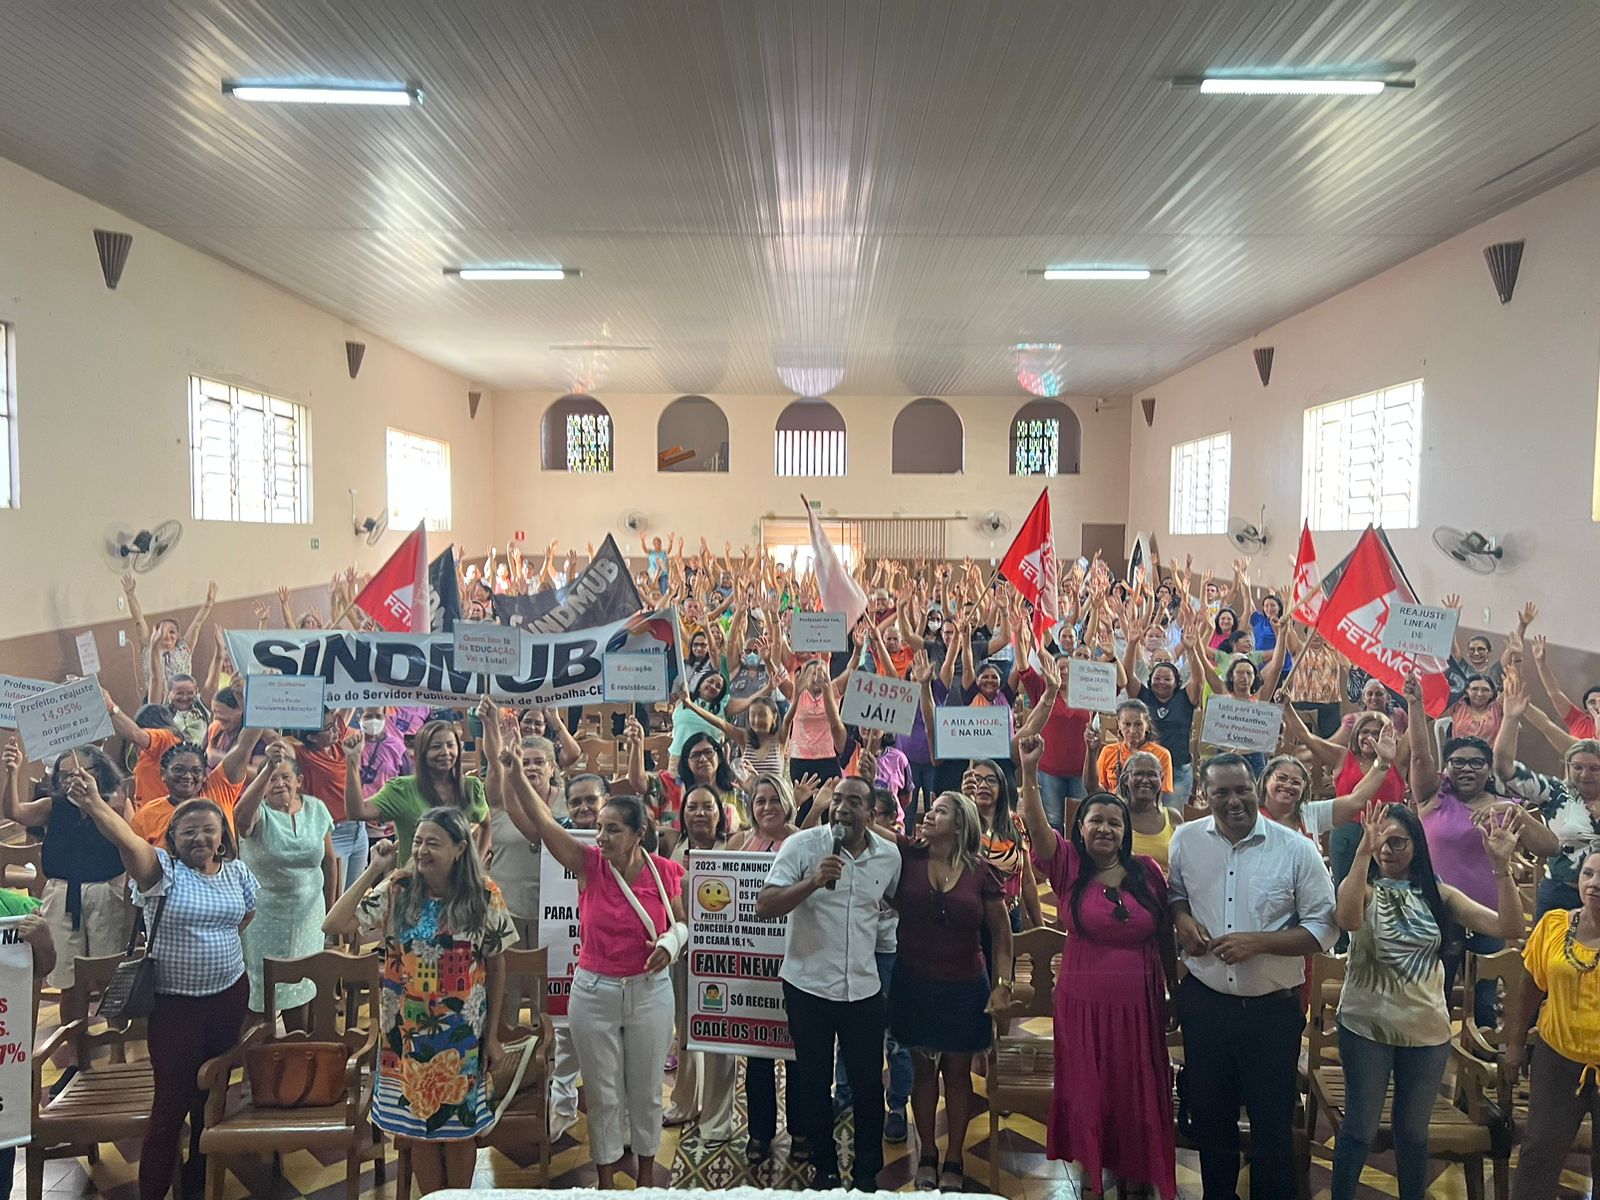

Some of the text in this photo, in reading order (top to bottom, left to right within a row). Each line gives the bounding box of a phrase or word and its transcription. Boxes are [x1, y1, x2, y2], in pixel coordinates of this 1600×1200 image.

[1400, 607, 1446, 620] REAJUSTE
[1403, 618, 1437, 630] LINEAR
[59, 683, 94, 700] reajuste
[345, 690, 359, 700] do
[363, 688, 412, 700] Servidor
[518, 697, 532, 705] de
[855, 677, 913, 703] 14,95%
[42, 702, 82, 722] 14,95%
[860, 703, 896, 724] JÁ!!
[42, 728, 53, 737] no
[79, 716, 89, 725] na
[958, 728, 972, 736] NA
[695, 861, 716, 871] 2023
[722, 861, 740, 872] MEC
[739, 891, 749, 900] OS
[544, 906, 573, 920] PARA
[700, 912, 727, 920] PREFEITO
[693, 923, 733, 934] CONCEDER
[734, 925, 740, 934] O
[741, 926, 766, 936] MAIOR
[693, 935, 704, 944] DO
[705, 935, 730, 946] CEARÁ
[695, 953, 736, 974] FAKE
[730, 993, 743, 1006] SÓ
[745, 995, 779, 1010] RECEBI
[693, 1019, 728, 1038] CADÊ
[731, 1023, 749, 1039] OS
